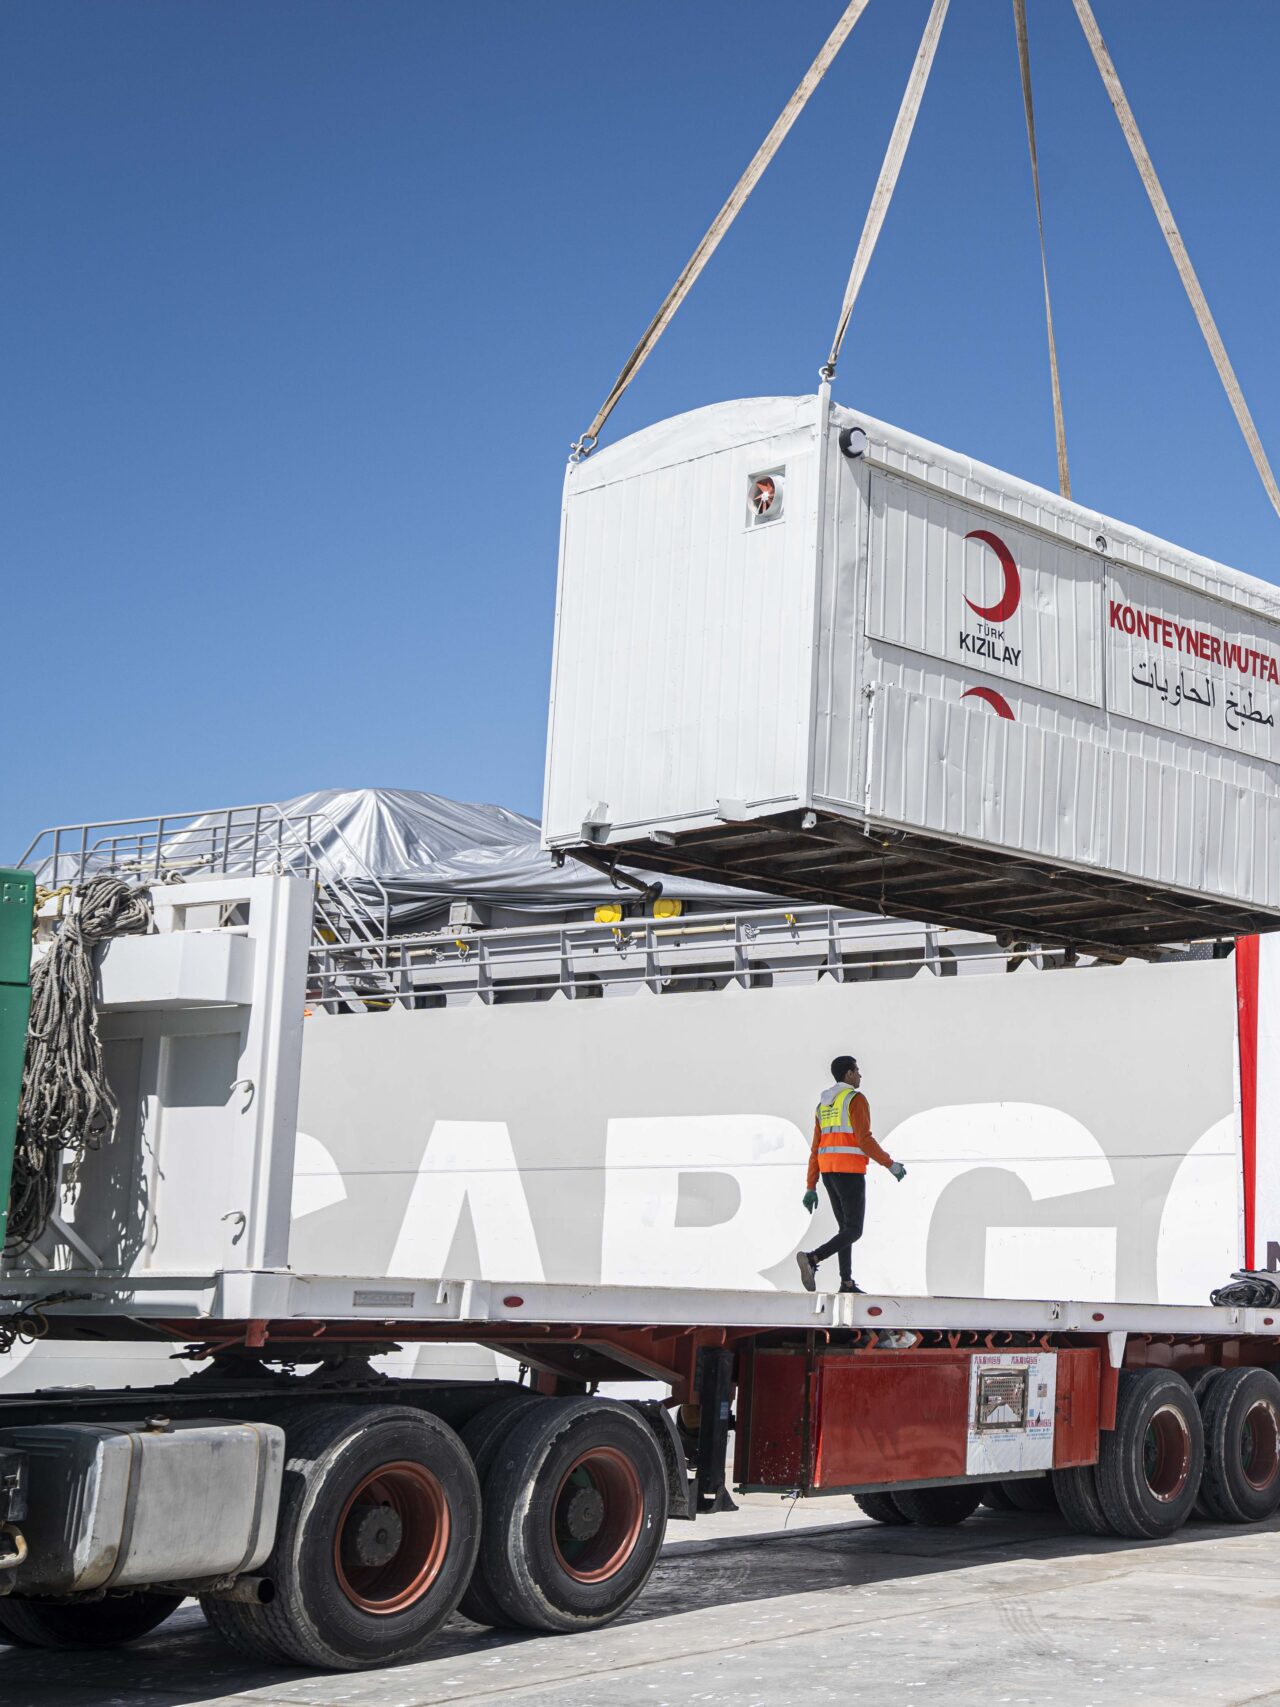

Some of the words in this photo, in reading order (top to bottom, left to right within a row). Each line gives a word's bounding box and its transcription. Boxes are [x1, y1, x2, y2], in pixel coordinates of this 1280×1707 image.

[959, 630, 1022, 667] KIZILAY
[976, 622, 1005, 641] TÜRK
[1109, 600, 1222, 667] KONTEYNER
[1131, 661, 1216, 708] الحاويات
[1224, 690, 1275, 731] مطبخ
[292, 1101, 1240, 1300] ARG
